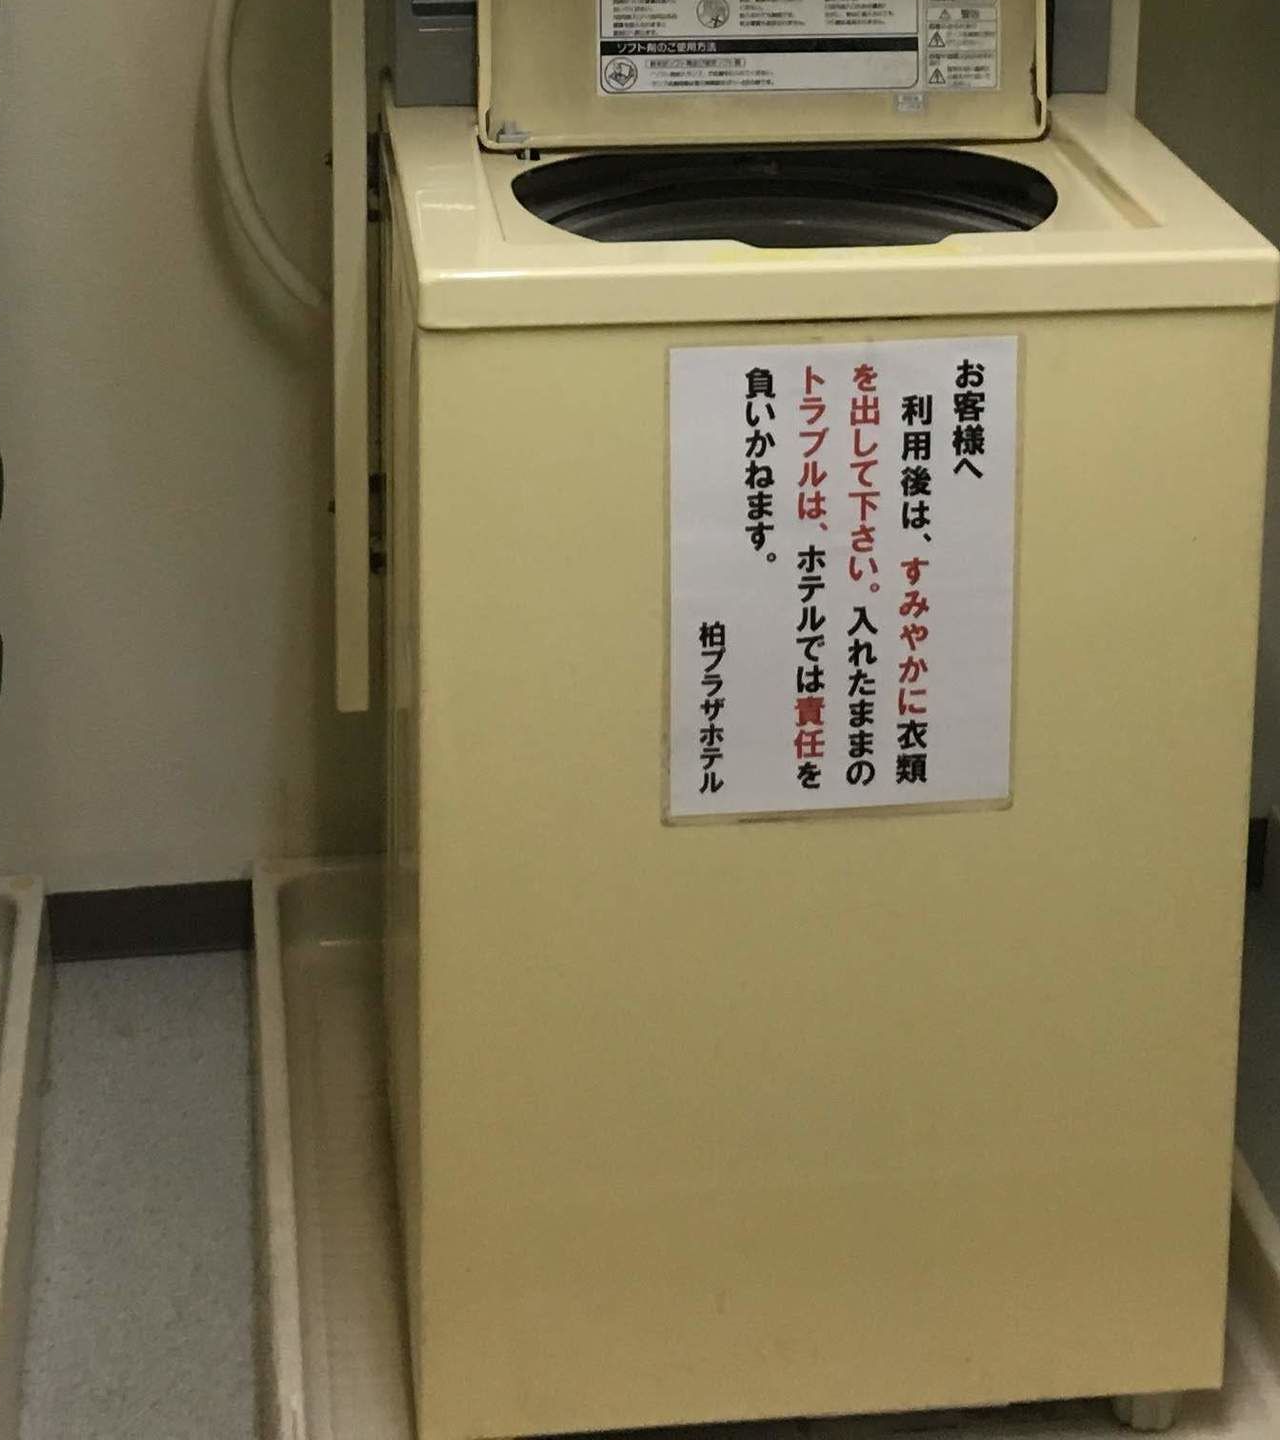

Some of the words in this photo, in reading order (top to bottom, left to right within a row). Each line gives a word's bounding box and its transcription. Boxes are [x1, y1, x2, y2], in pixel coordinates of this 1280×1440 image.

[745, 367, 777, 564] 負いかねます。
[952, 359, 985, 479] お客様へ
[698, 621, 726, 794] 柏プラザホテル
